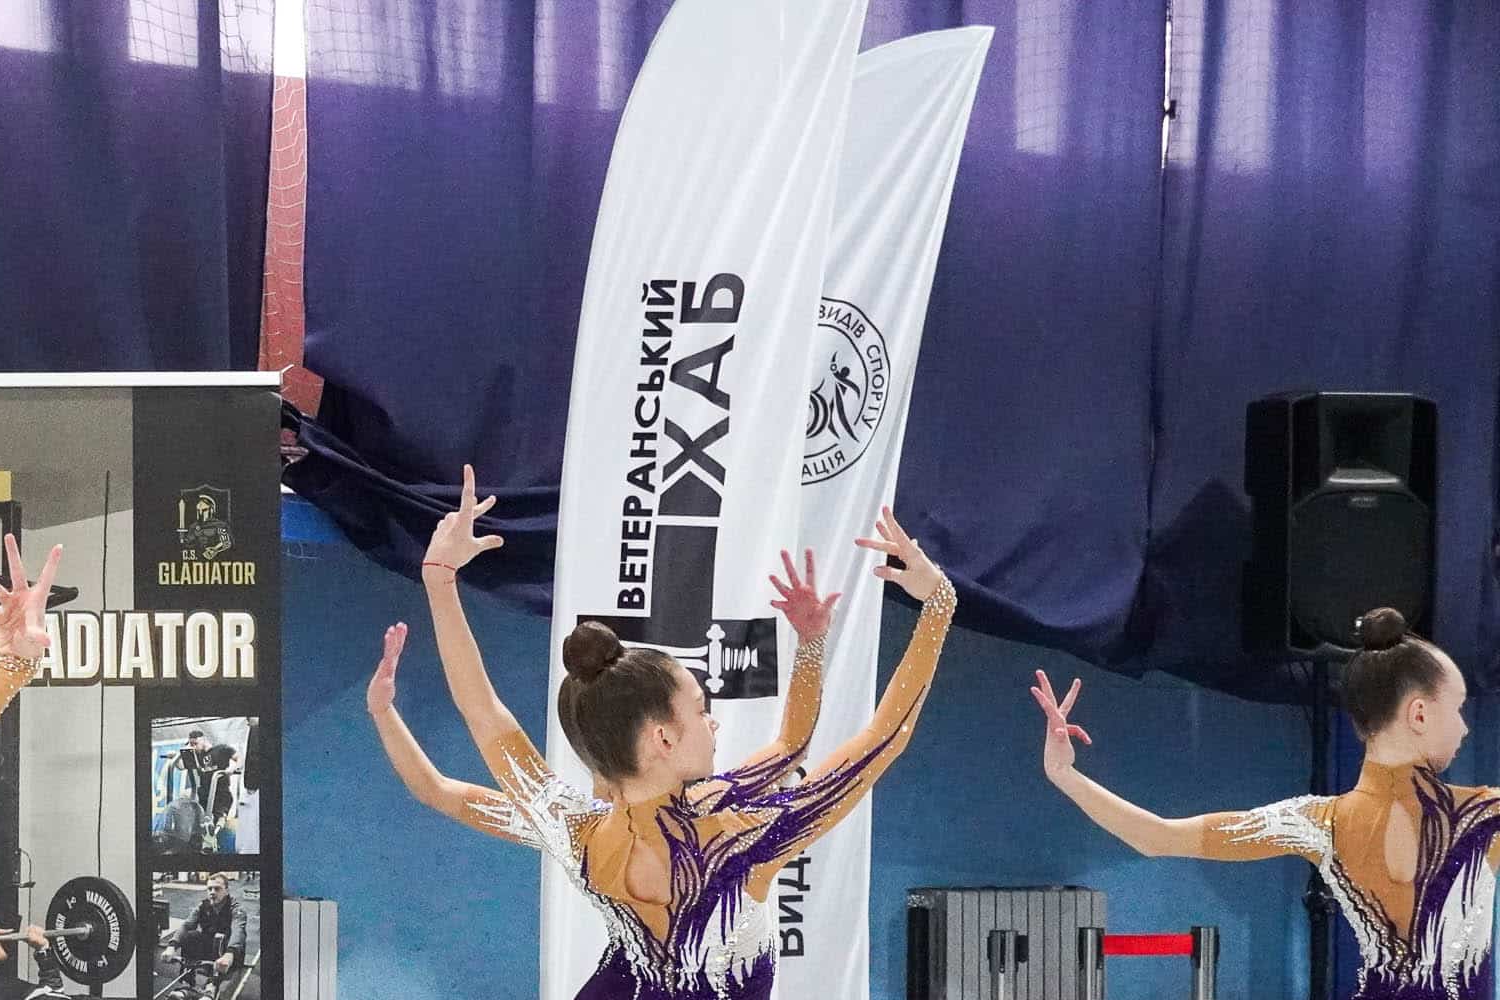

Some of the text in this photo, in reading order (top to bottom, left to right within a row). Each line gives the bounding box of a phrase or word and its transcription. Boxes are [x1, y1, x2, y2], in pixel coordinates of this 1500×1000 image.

[661, 272, 746, 487] ХАБ
[861, 344, 885, 430] СПОРТУ
[617, 279, 678, 611] ВЕТЕРАНСЬКИЙ
[801, 450, 846, 479] АЦІЯ
[158, 561, 256, 586] GLADIATOR
[778, 848, 812, 958] ВИД
